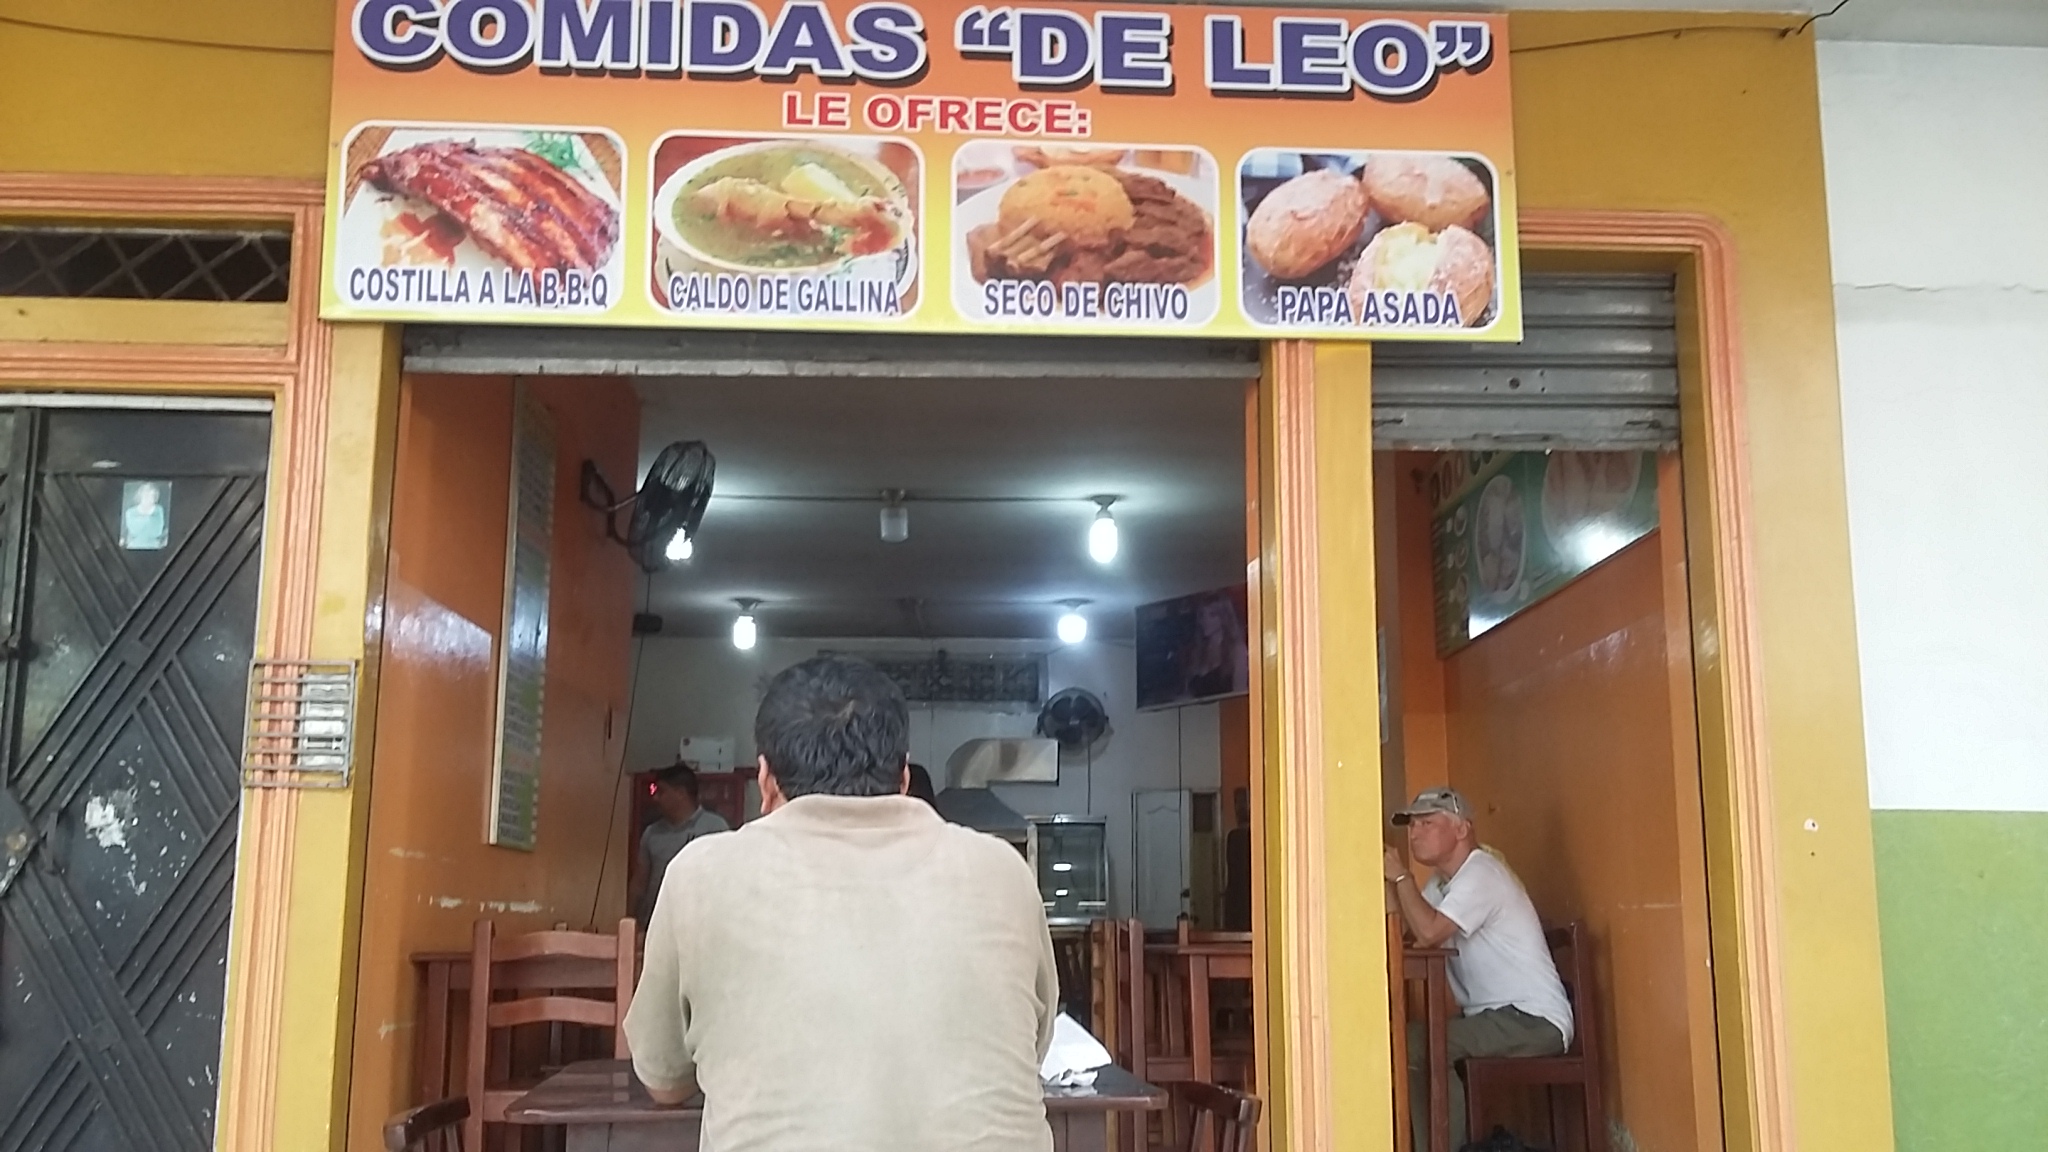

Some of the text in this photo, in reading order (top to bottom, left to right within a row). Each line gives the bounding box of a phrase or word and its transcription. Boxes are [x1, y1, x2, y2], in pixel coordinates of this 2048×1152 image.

[354, 0, 925, 78] COMIDAS
[784, 94, 1089, 135] LE OFRECE:
[349, 268, 470, 303] COSTILLA
[478, 270, 495, 303] A
[503, 271, 534, 305] LA
[670, 276, 899, 313] CALDO DE GALLINA
[984, 283, 1188, 320] SECO DE CHIVO
[1280, 290, 1461, 325] PAPA ASADA
